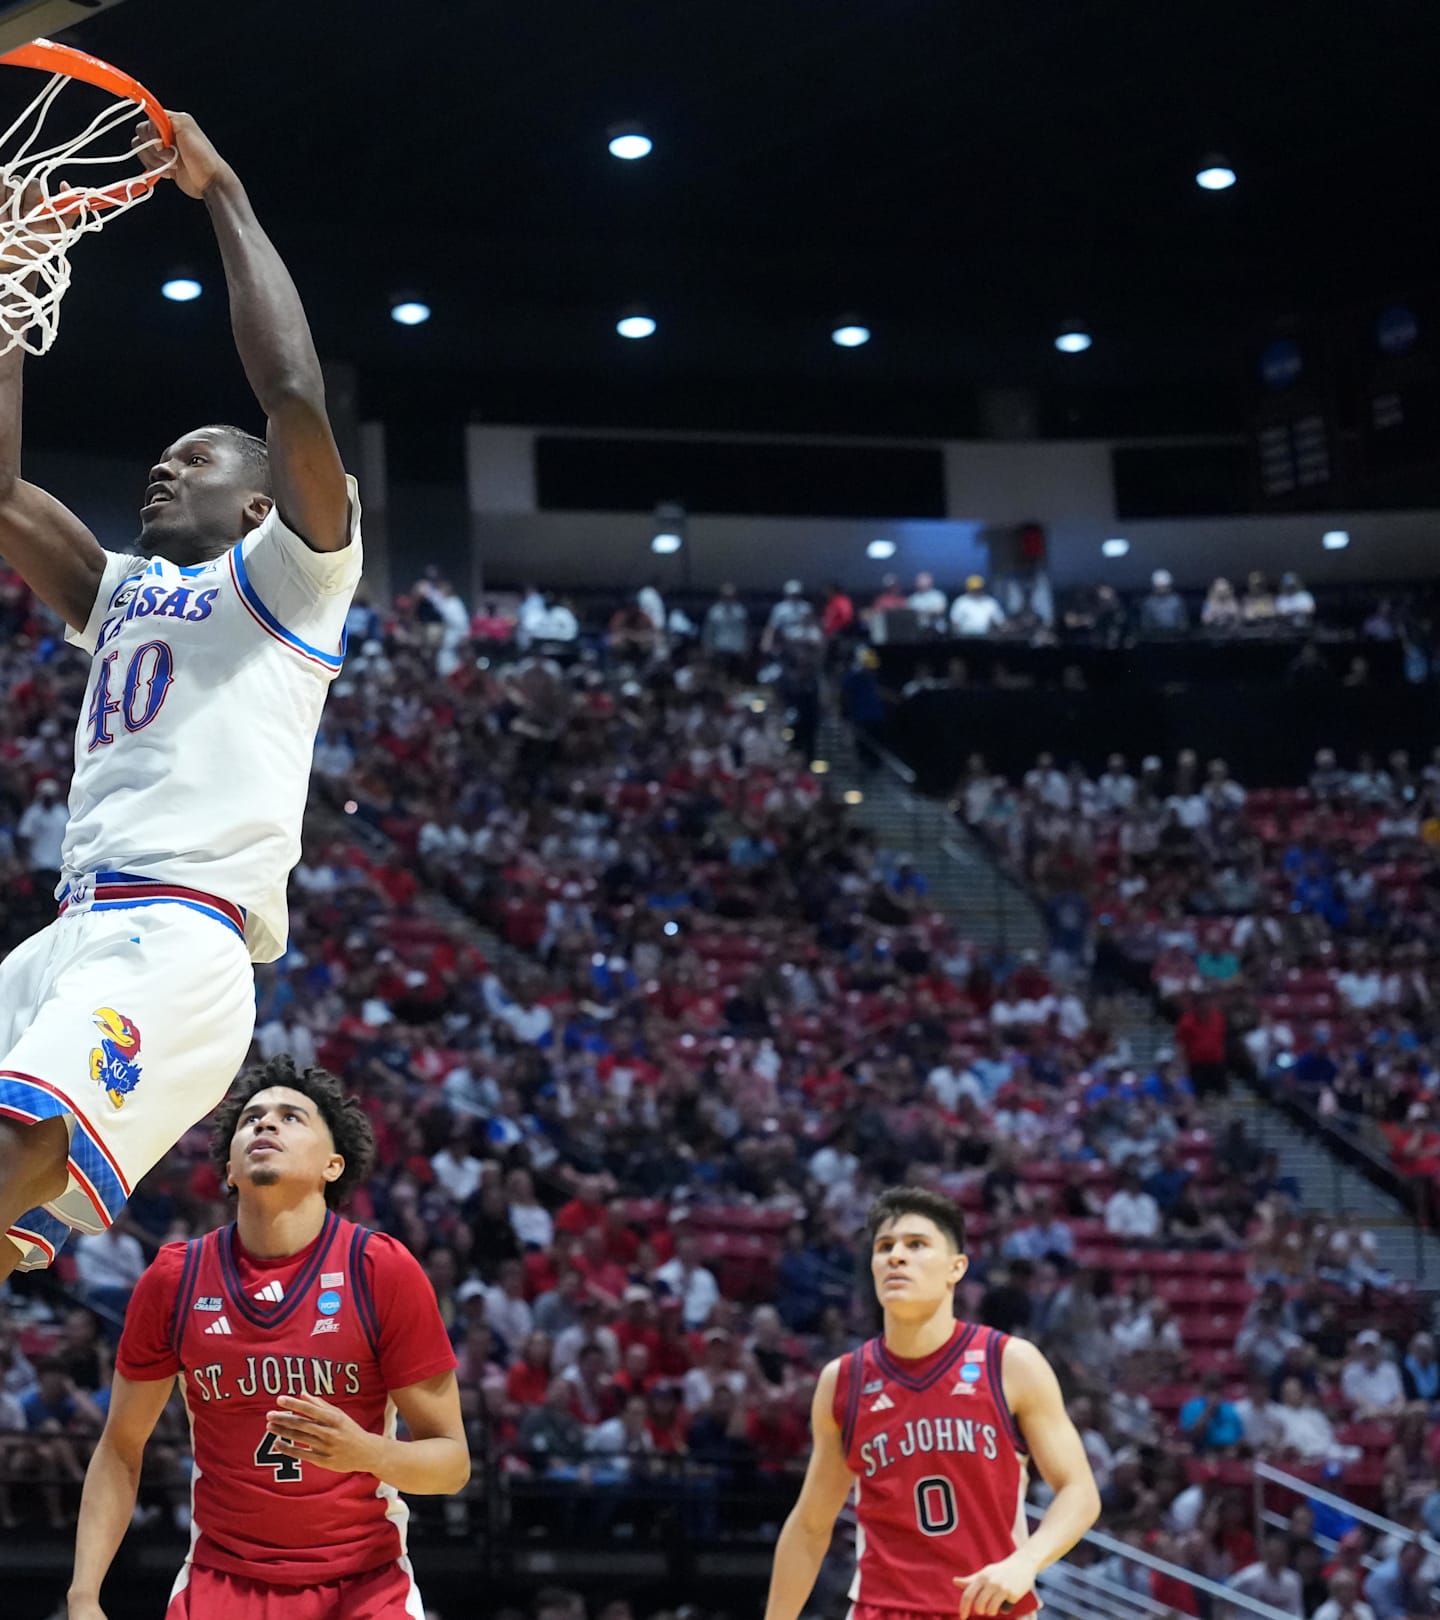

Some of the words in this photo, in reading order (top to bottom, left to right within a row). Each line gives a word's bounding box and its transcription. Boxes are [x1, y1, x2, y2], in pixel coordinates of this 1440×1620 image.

[87, 639, 175, 753] 40
[109, 1058, 128, 1079] KU
[194, 1364, 231, 1401] ST.
[237, 1356, 360, 1396] JOHN'S
[254, 1411, 312, 1482] 4
[860, 1432, 896, 1477] ST.
[898, 1418, 998, 1460] JOHN'S
[914, 1475, 958, 1536] 0
